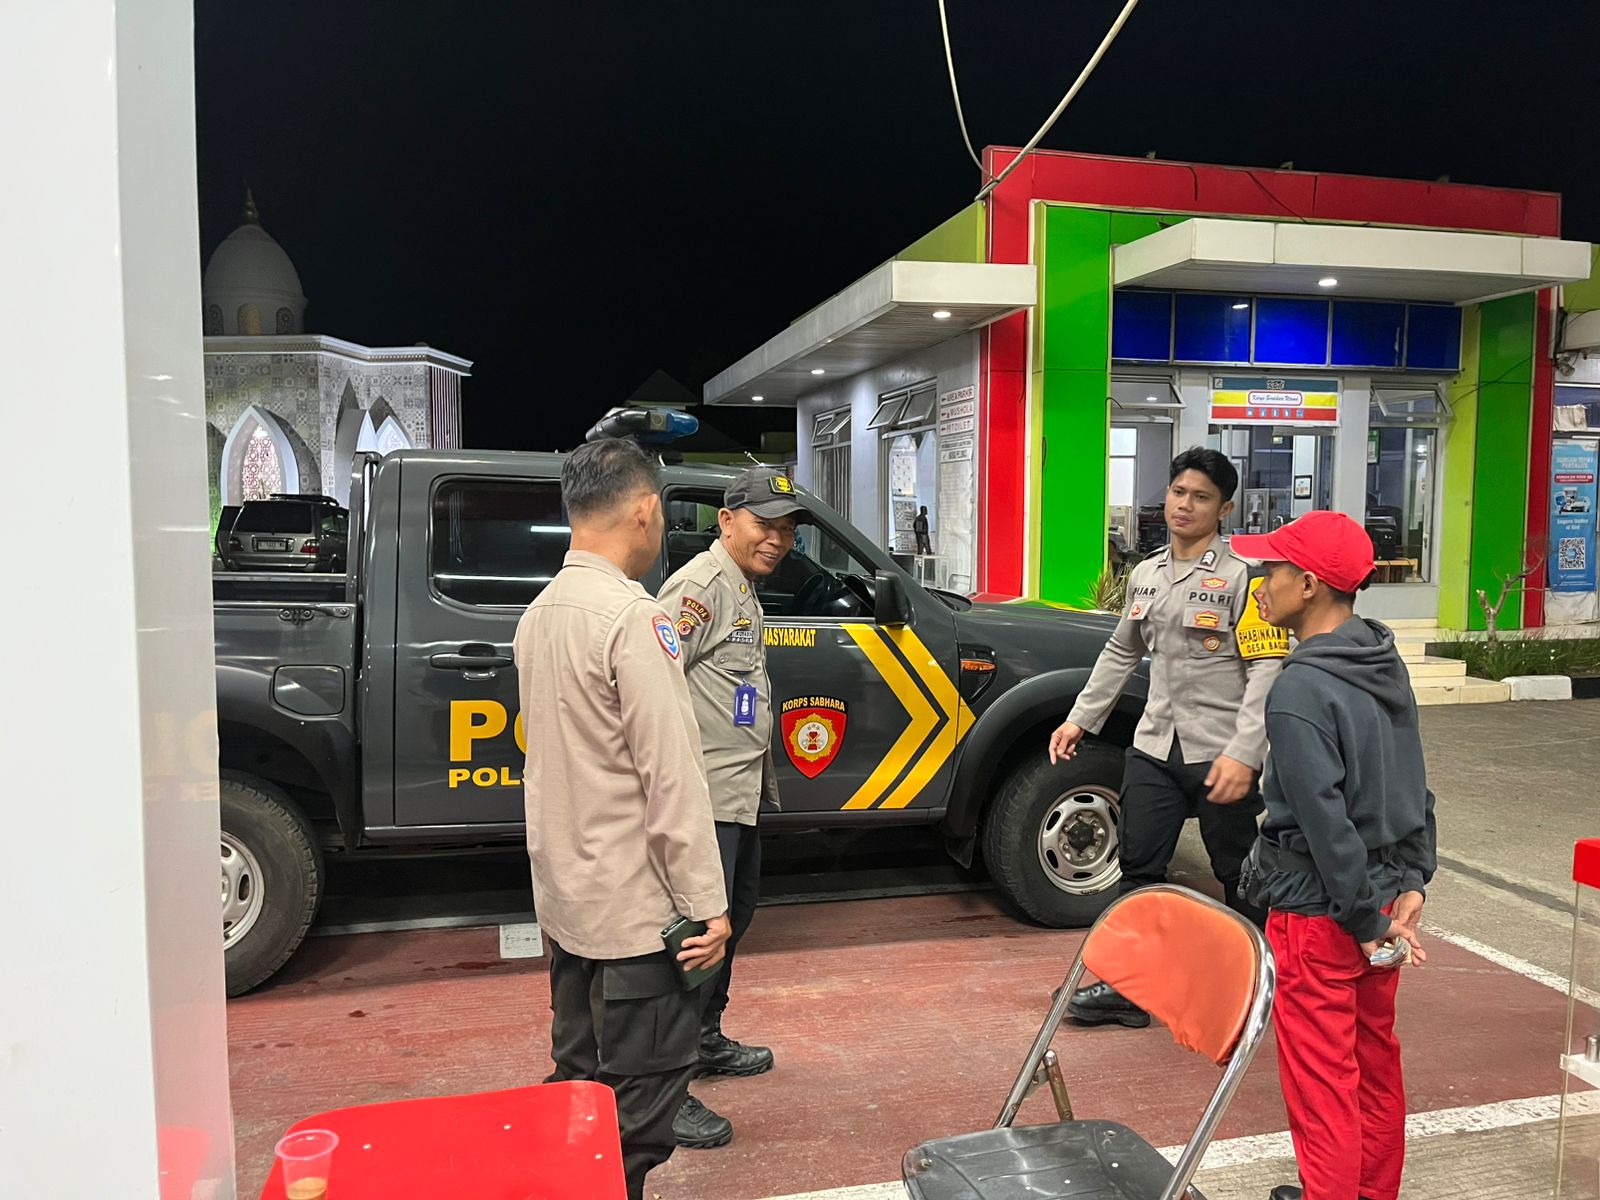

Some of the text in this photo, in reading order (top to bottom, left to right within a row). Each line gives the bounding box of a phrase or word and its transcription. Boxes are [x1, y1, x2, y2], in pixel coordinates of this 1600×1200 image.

[1189, 591, 1232, 606] POLRI
[686, 599, 707, 618] POLDA
[1246, 642, 1266, 654] DESA
[782, 697, 845, 712] KORPS SABHARA
[449, 699, 527, 762] P
[448, 767, 524, 788] POL
